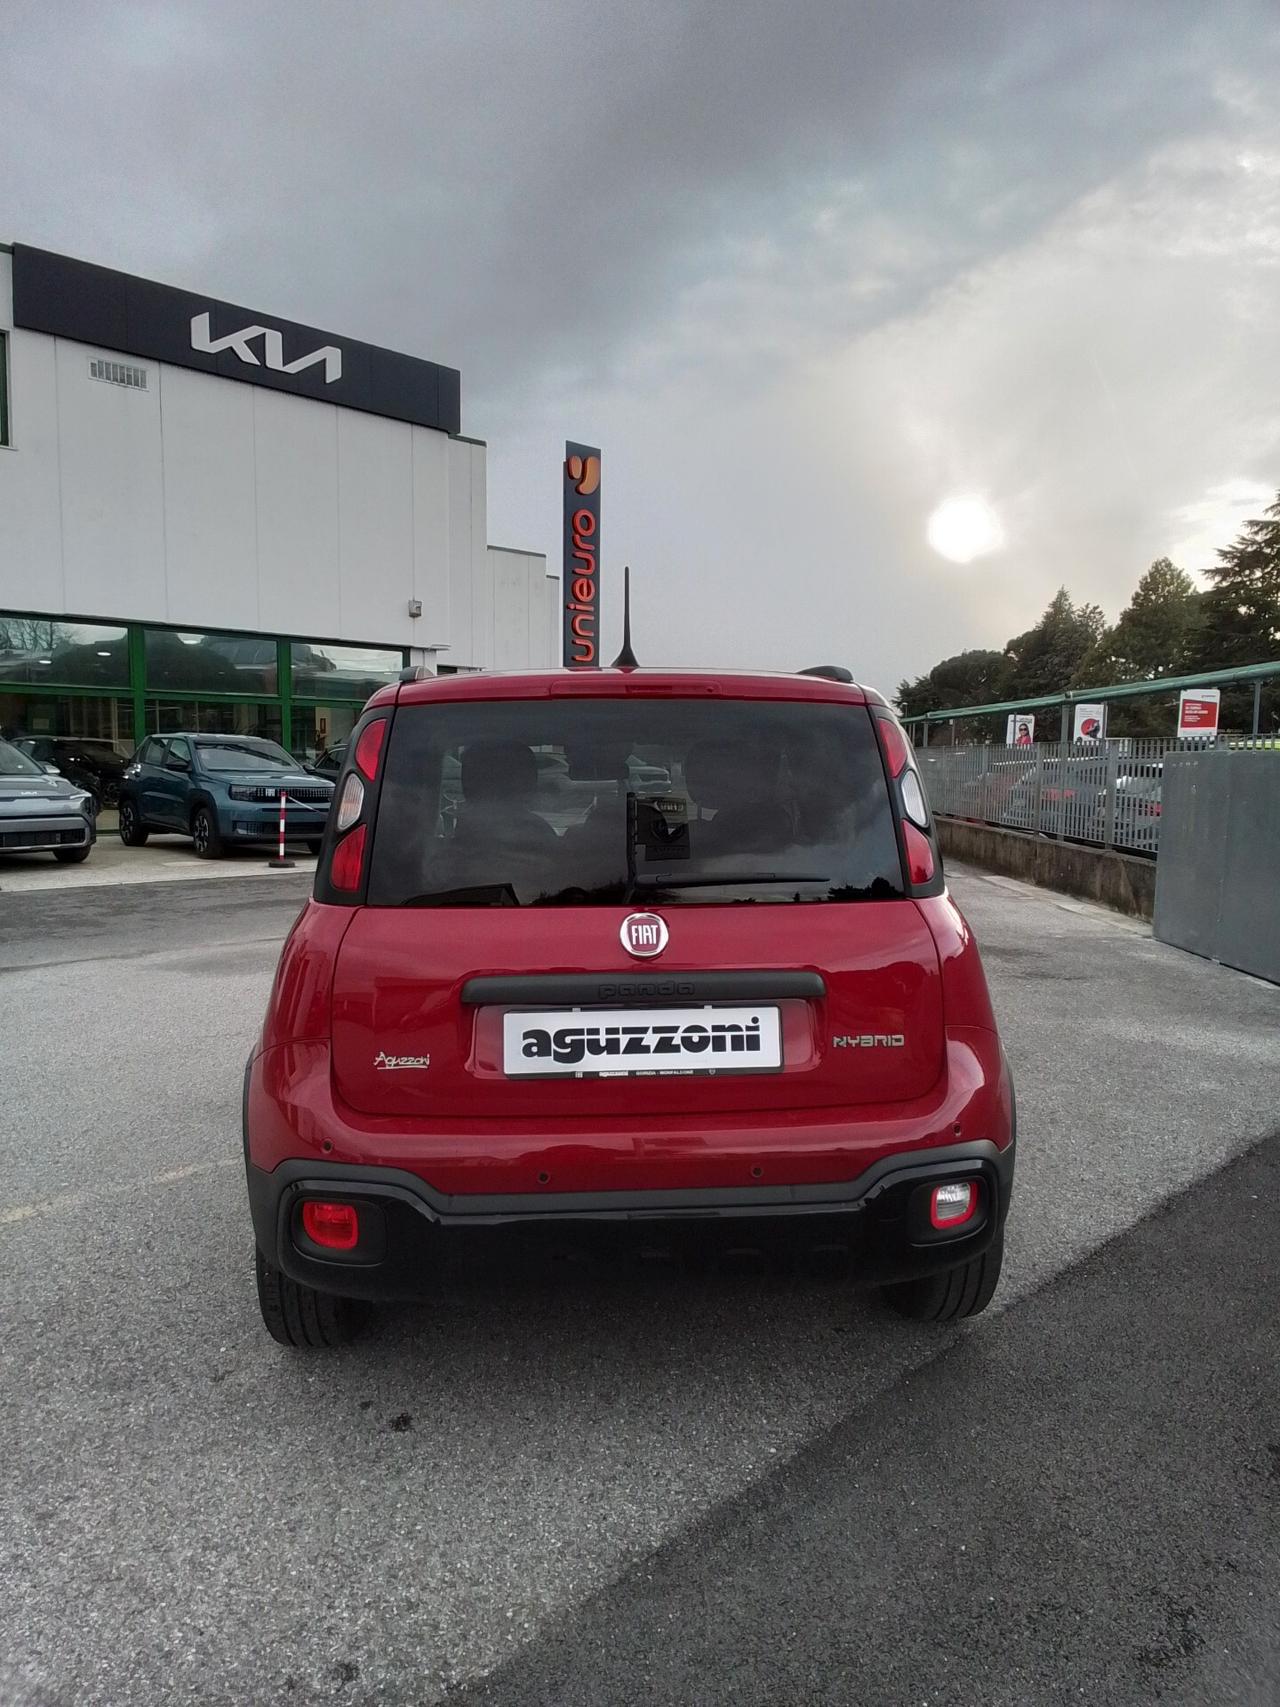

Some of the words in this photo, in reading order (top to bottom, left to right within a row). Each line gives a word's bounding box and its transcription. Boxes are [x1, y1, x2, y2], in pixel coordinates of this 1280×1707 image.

[191, 311, 342, 384] KIA
[567, 508, 596, 662] unieuro
[631, 924, 658, 945] FIAT
[521, 1016, 761, 1064] aguzzoni
